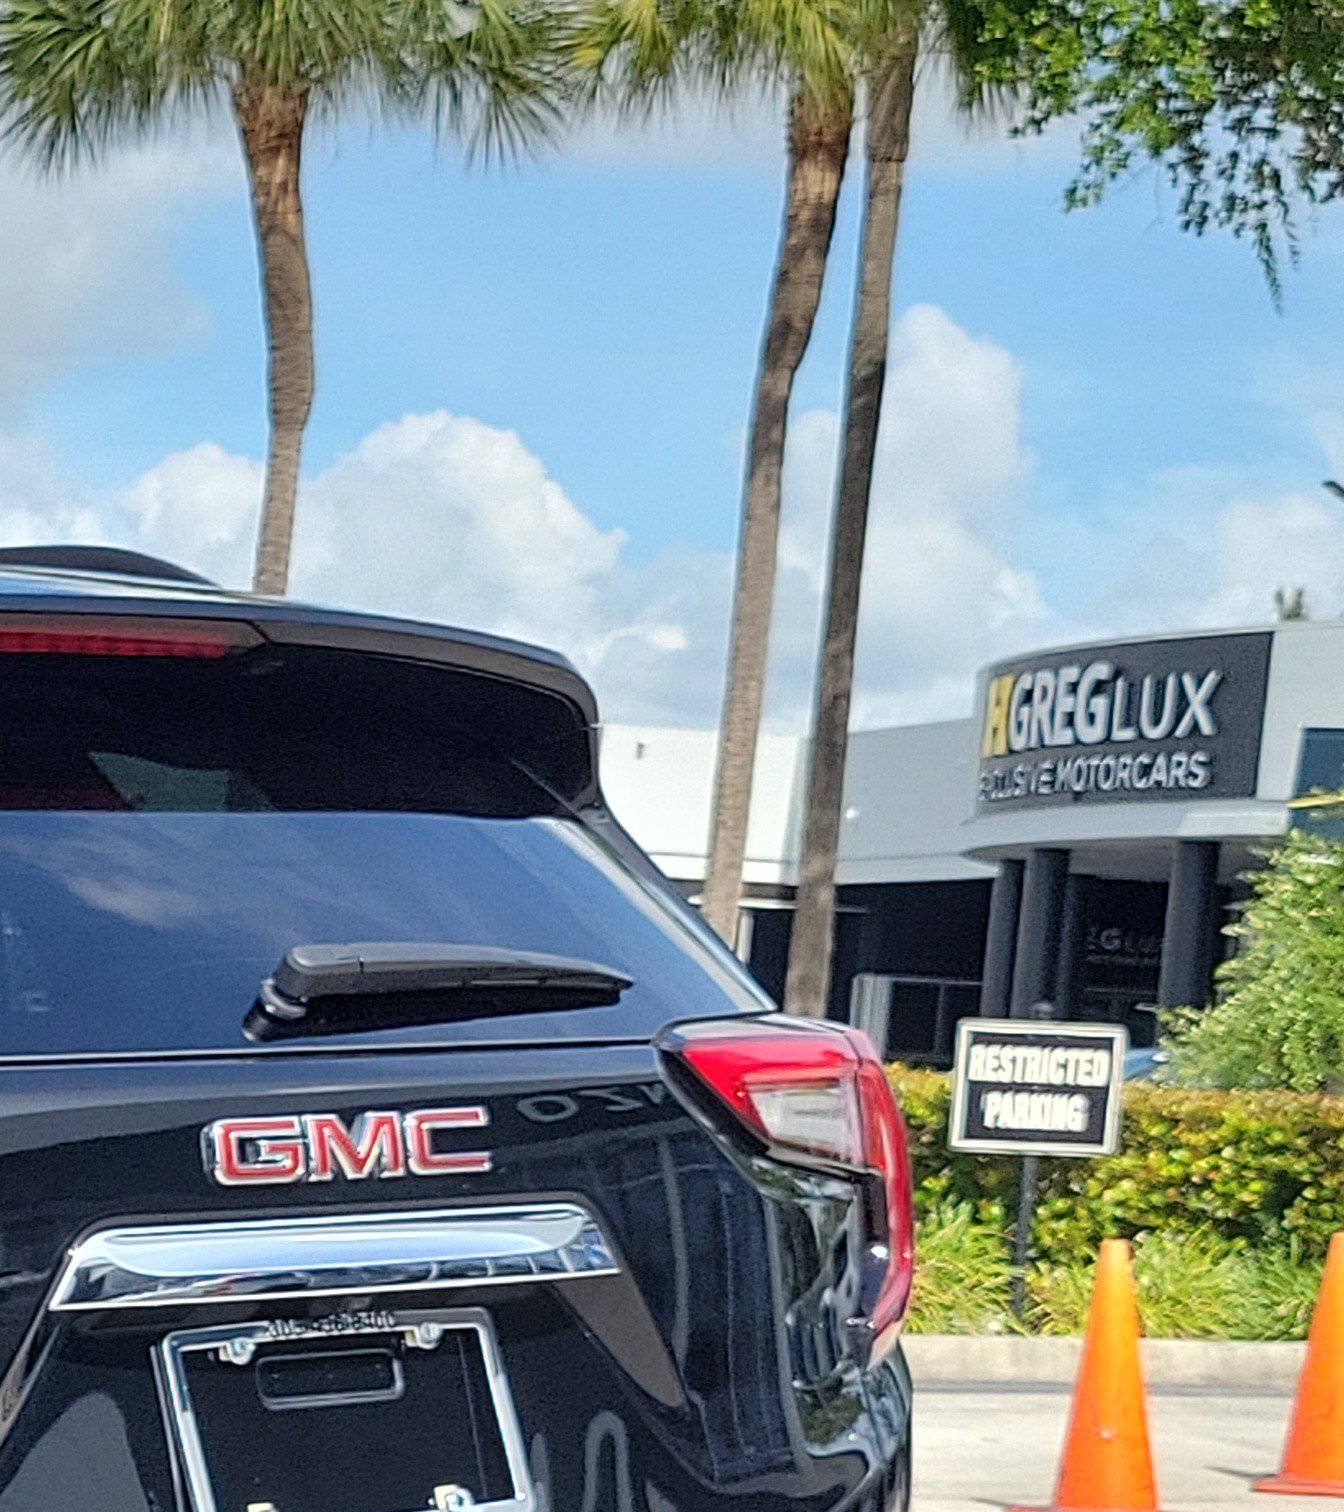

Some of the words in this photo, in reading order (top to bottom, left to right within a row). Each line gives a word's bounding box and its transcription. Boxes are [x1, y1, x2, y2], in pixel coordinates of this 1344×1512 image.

[967, 1043, 1111, 1087] RESTRICTED
[981, 1091, 1089, 1132] PARKING
[201, 1106, 493, 1187] GMC
